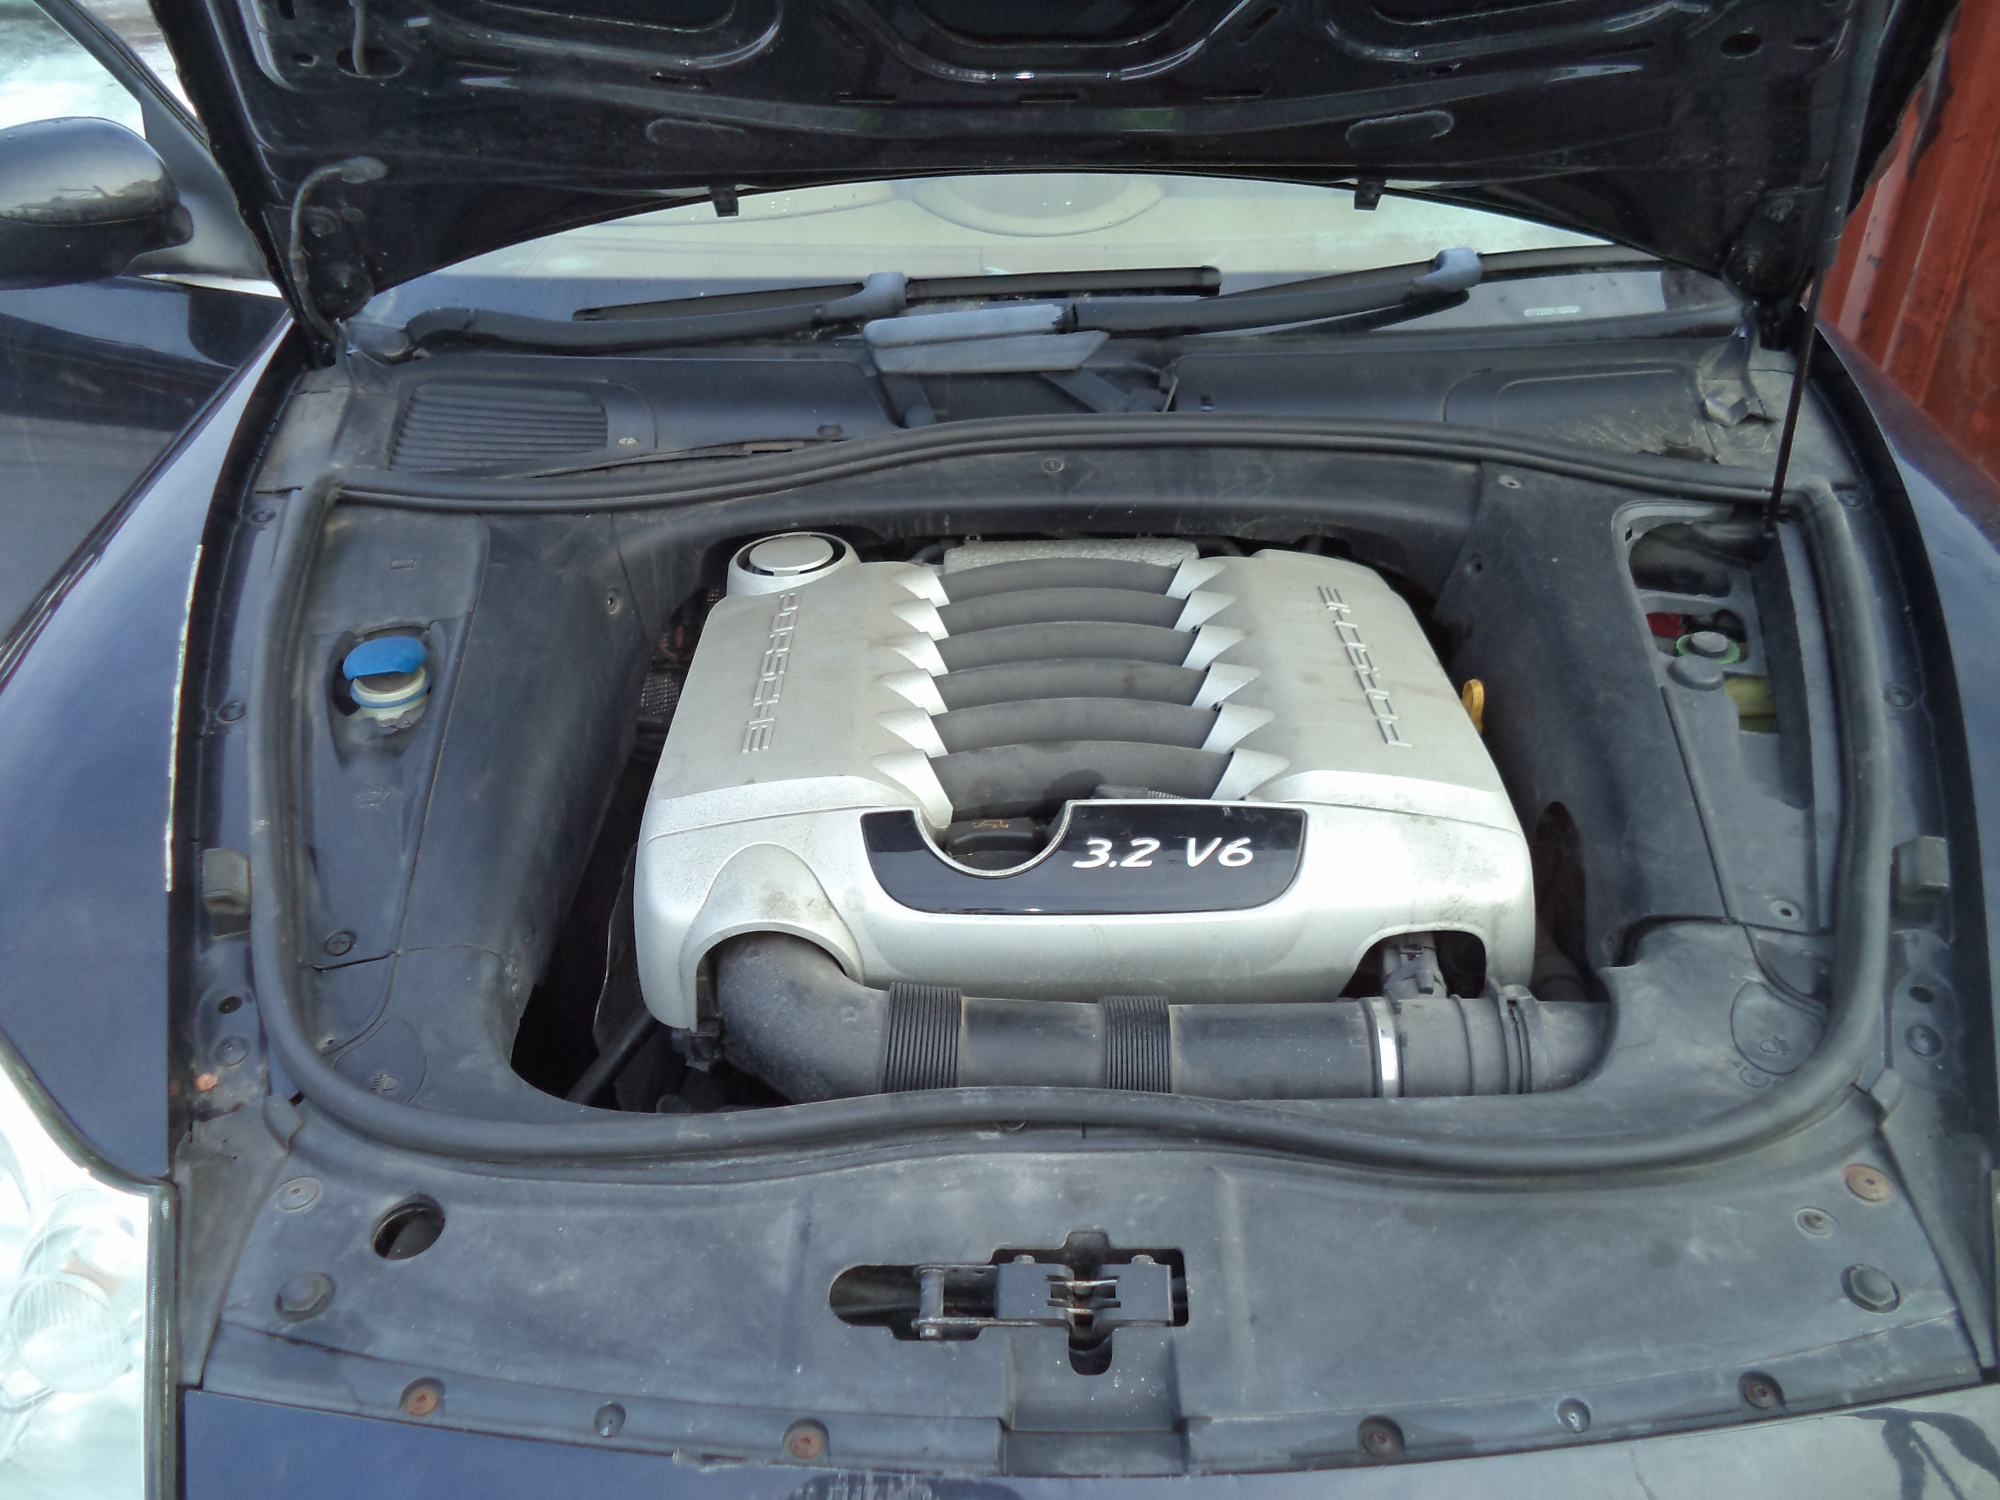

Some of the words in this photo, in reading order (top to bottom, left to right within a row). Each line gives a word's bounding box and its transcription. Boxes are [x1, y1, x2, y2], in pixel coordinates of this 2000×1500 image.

[741, 589, 801, 754] PORSCHE
[1316, 585, 1413, 747] PORSCHE
[1072, 837, 1161, 869] 3.2
[1186, 836, 1253, 868] V6
